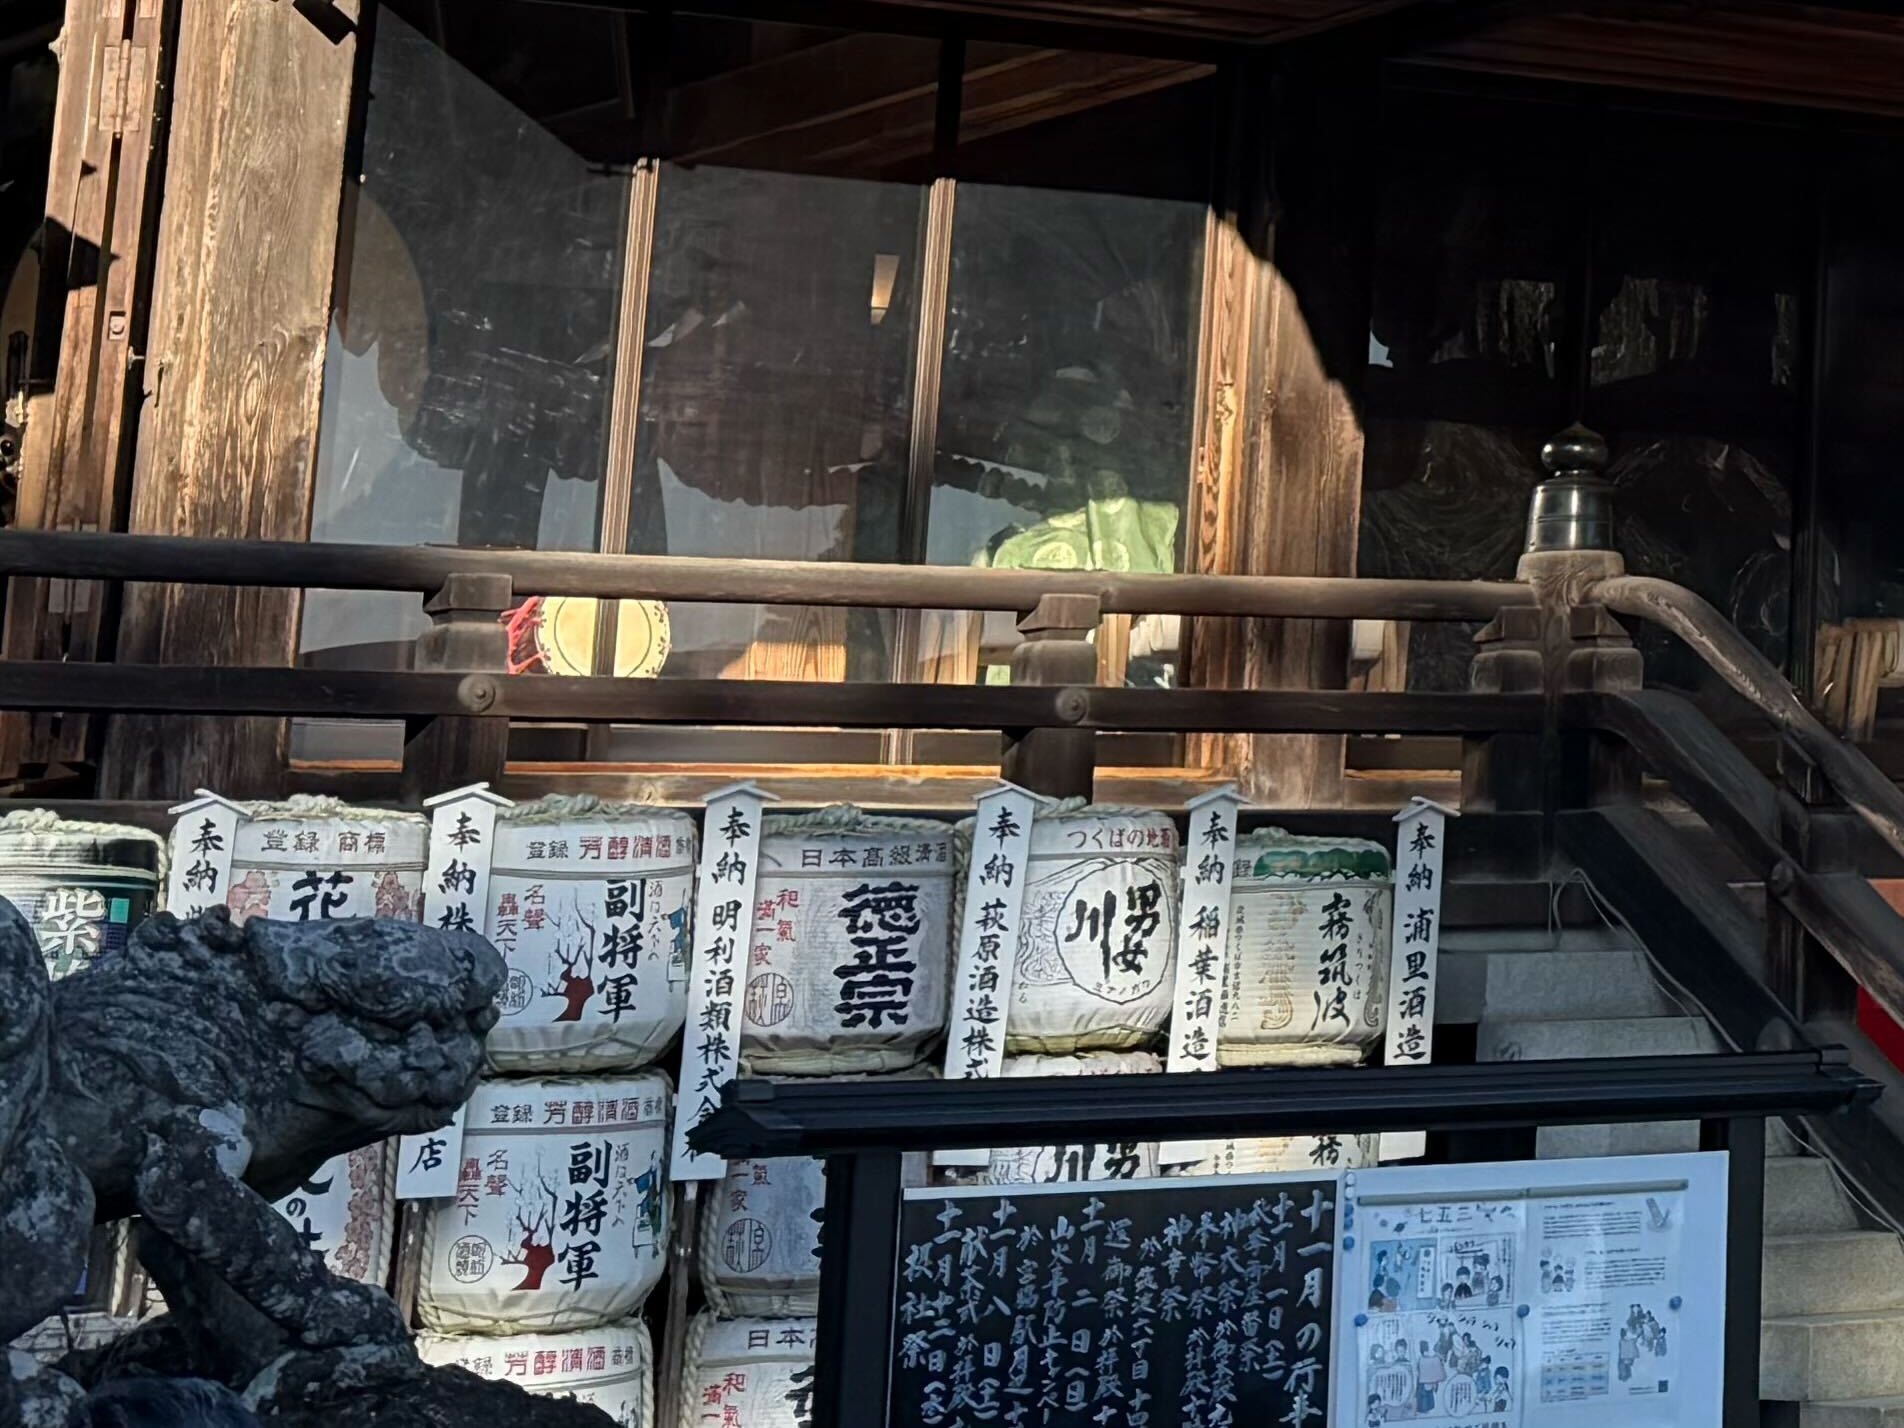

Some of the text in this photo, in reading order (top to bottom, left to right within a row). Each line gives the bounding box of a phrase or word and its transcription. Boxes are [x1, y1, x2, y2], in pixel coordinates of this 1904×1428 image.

[183, 818, 225, 893] 奉納
[261, 829, 386, 854] 登録 商標
[438, 811, 481, 895] 奉納
[711, 806, 750, 885] 奉納
[979, 806, 1020, 888] 奉納
[1067, 828, 1171, 850] つくばの地酒
[1195, 811, 1229, 885] 奉納
[1405, 822, 1436, 891] 奉納
[1419, 1205, 1473, 1223] 七五三
[748, 1327, 816, 1351] 日本
